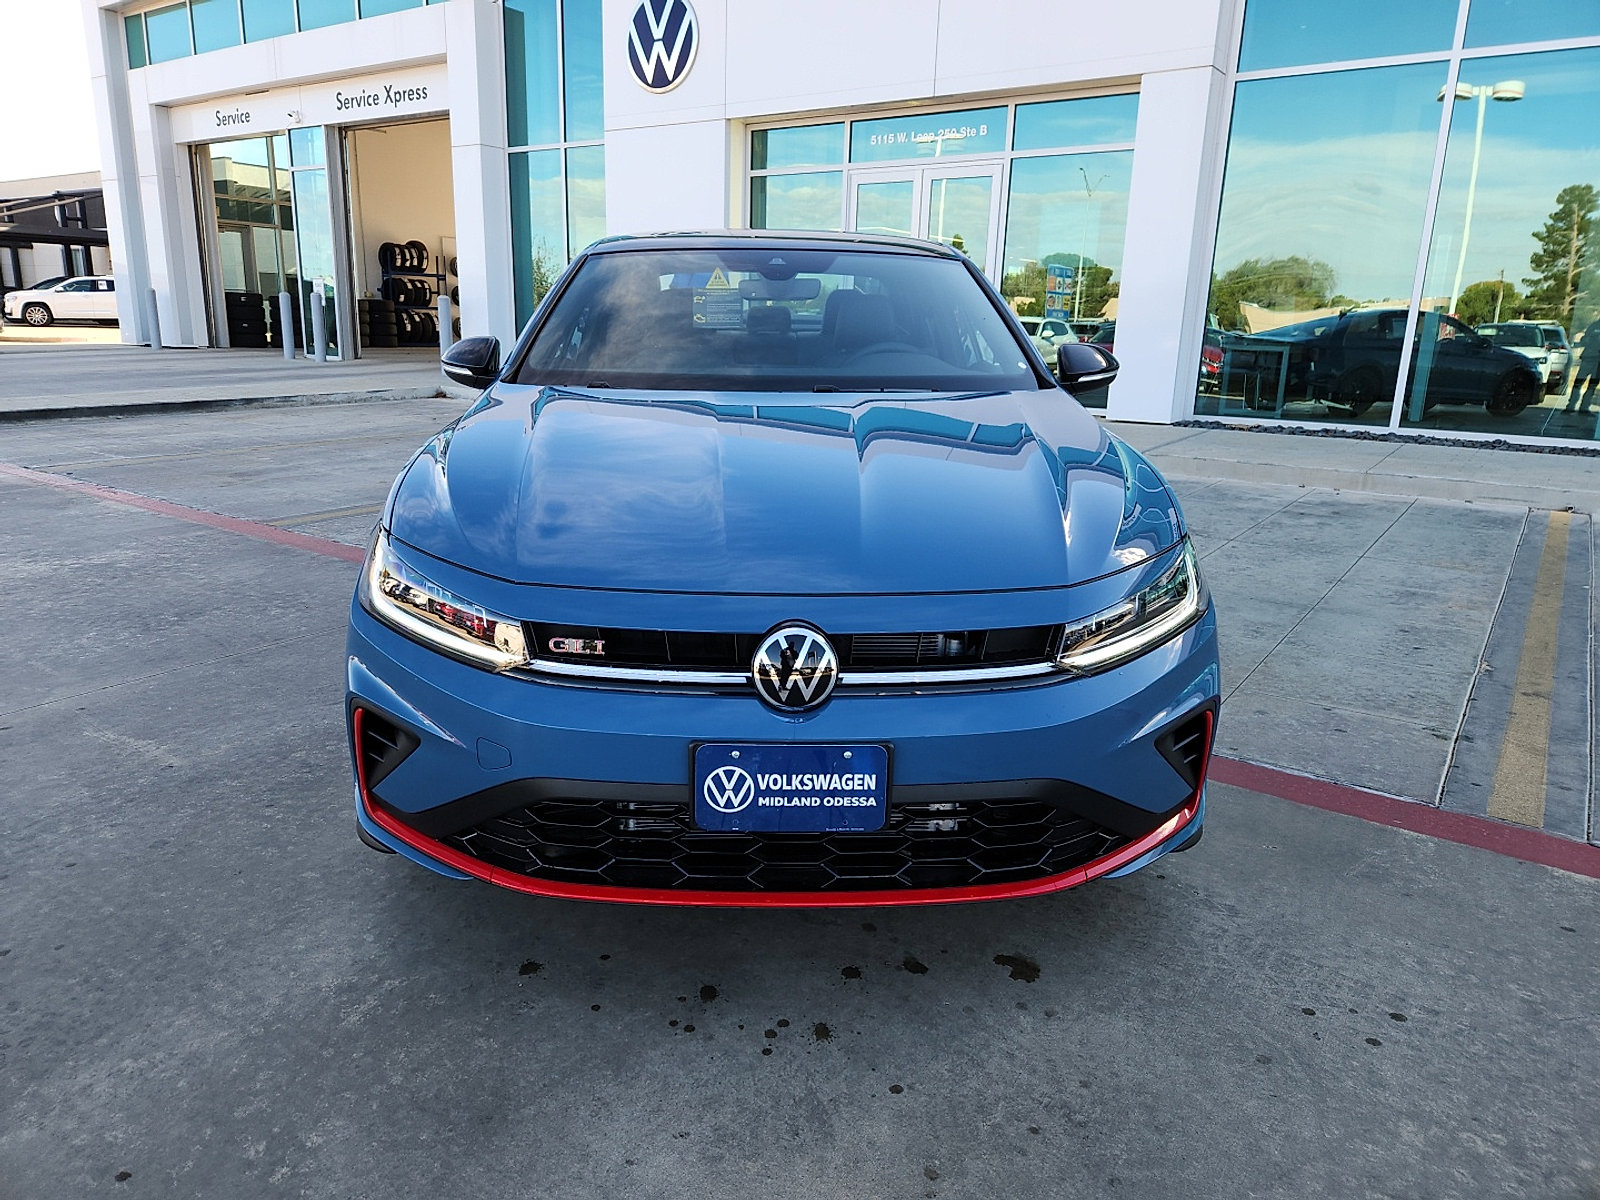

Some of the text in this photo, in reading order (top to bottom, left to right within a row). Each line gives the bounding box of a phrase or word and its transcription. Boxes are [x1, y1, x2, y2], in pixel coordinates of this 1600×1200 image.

[335, 85, 428, 111] Service Xpress
[215, 108, 250, 127] Service
[871, 133, 895, 145] 5115
[897, 132, 908, 143] W.
[960, 126, 977, 138] Ste
[980, 124, 988, 136] B
[757, 774, 877, 791] VOLKSWAGEN
[758, 797, 877, 807] MIDLAND ODESSA
